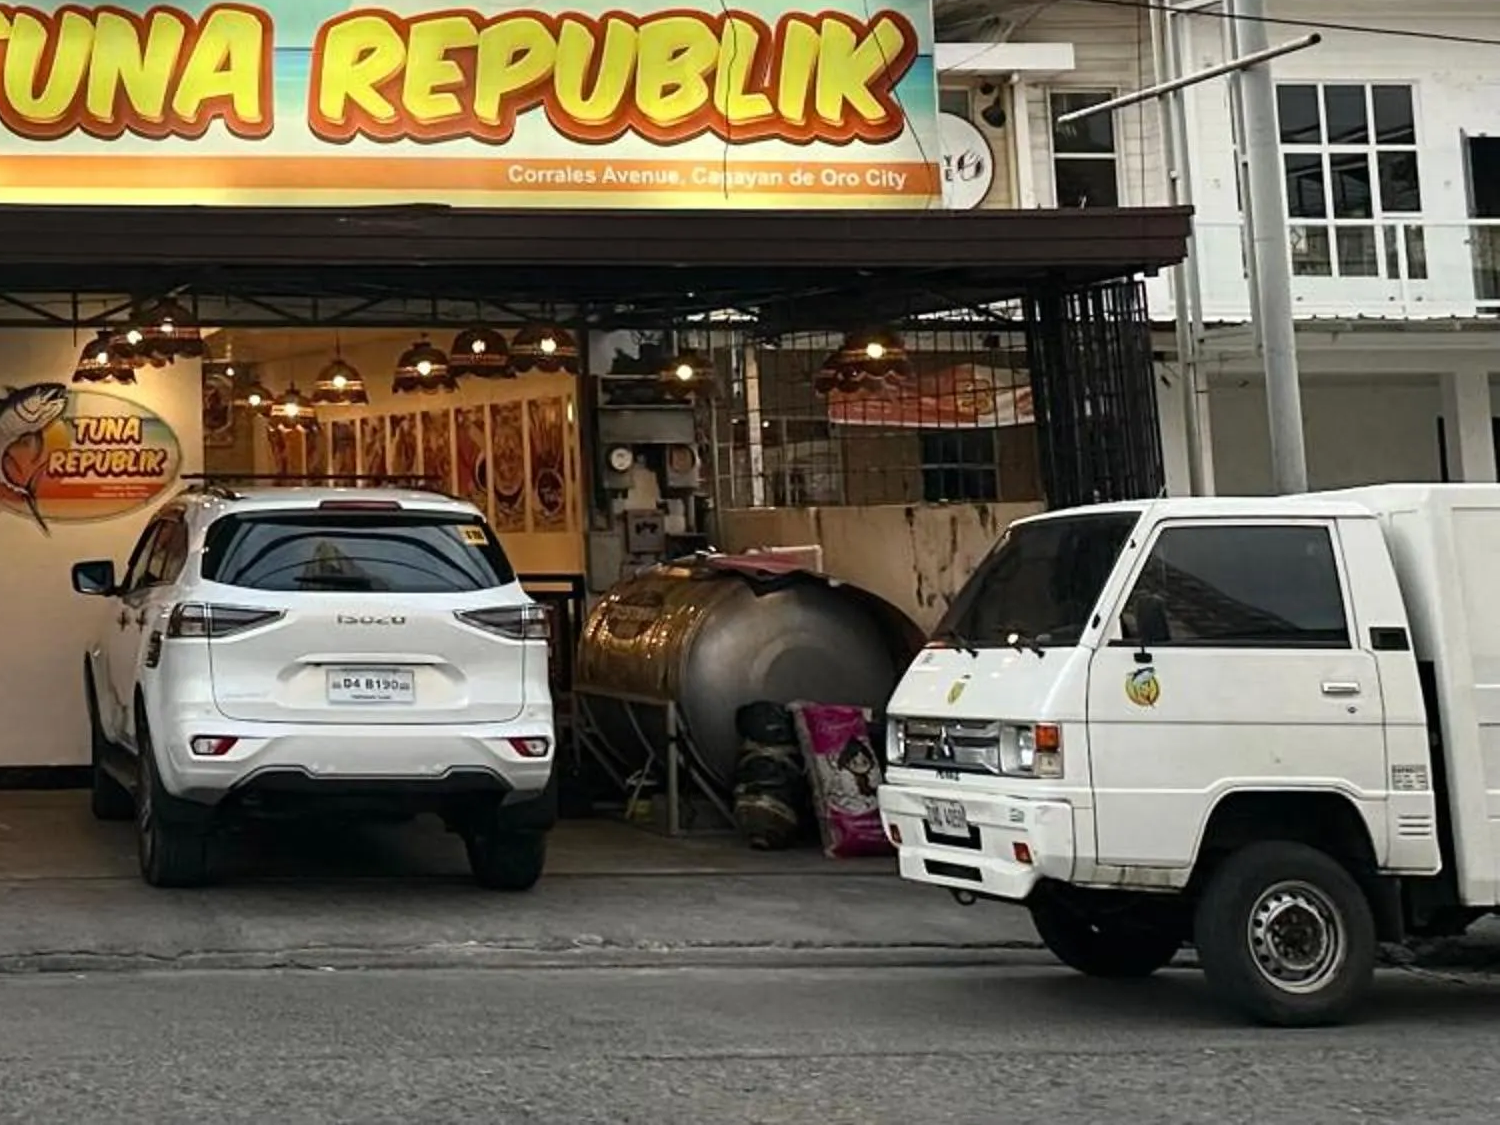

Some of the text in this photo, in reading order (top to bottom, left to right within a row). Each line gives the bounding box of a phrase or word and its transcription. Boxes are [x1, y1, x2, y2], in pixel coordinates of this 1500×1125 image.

[308, 8, 918, 146] REPUBLIK
[508, 165, 597, 184] Corrales
[691, 167, 783, 189] Cagayan
[789, 169, 815, 186] de
[820, 169, 860, 187] Oro
[865, 169, 908, 190] City
[71, 416, 142, 445] TUNA
[47, 448, 167, 478] REPUBLIK
[337, 614, 406, 625] ISUZU
